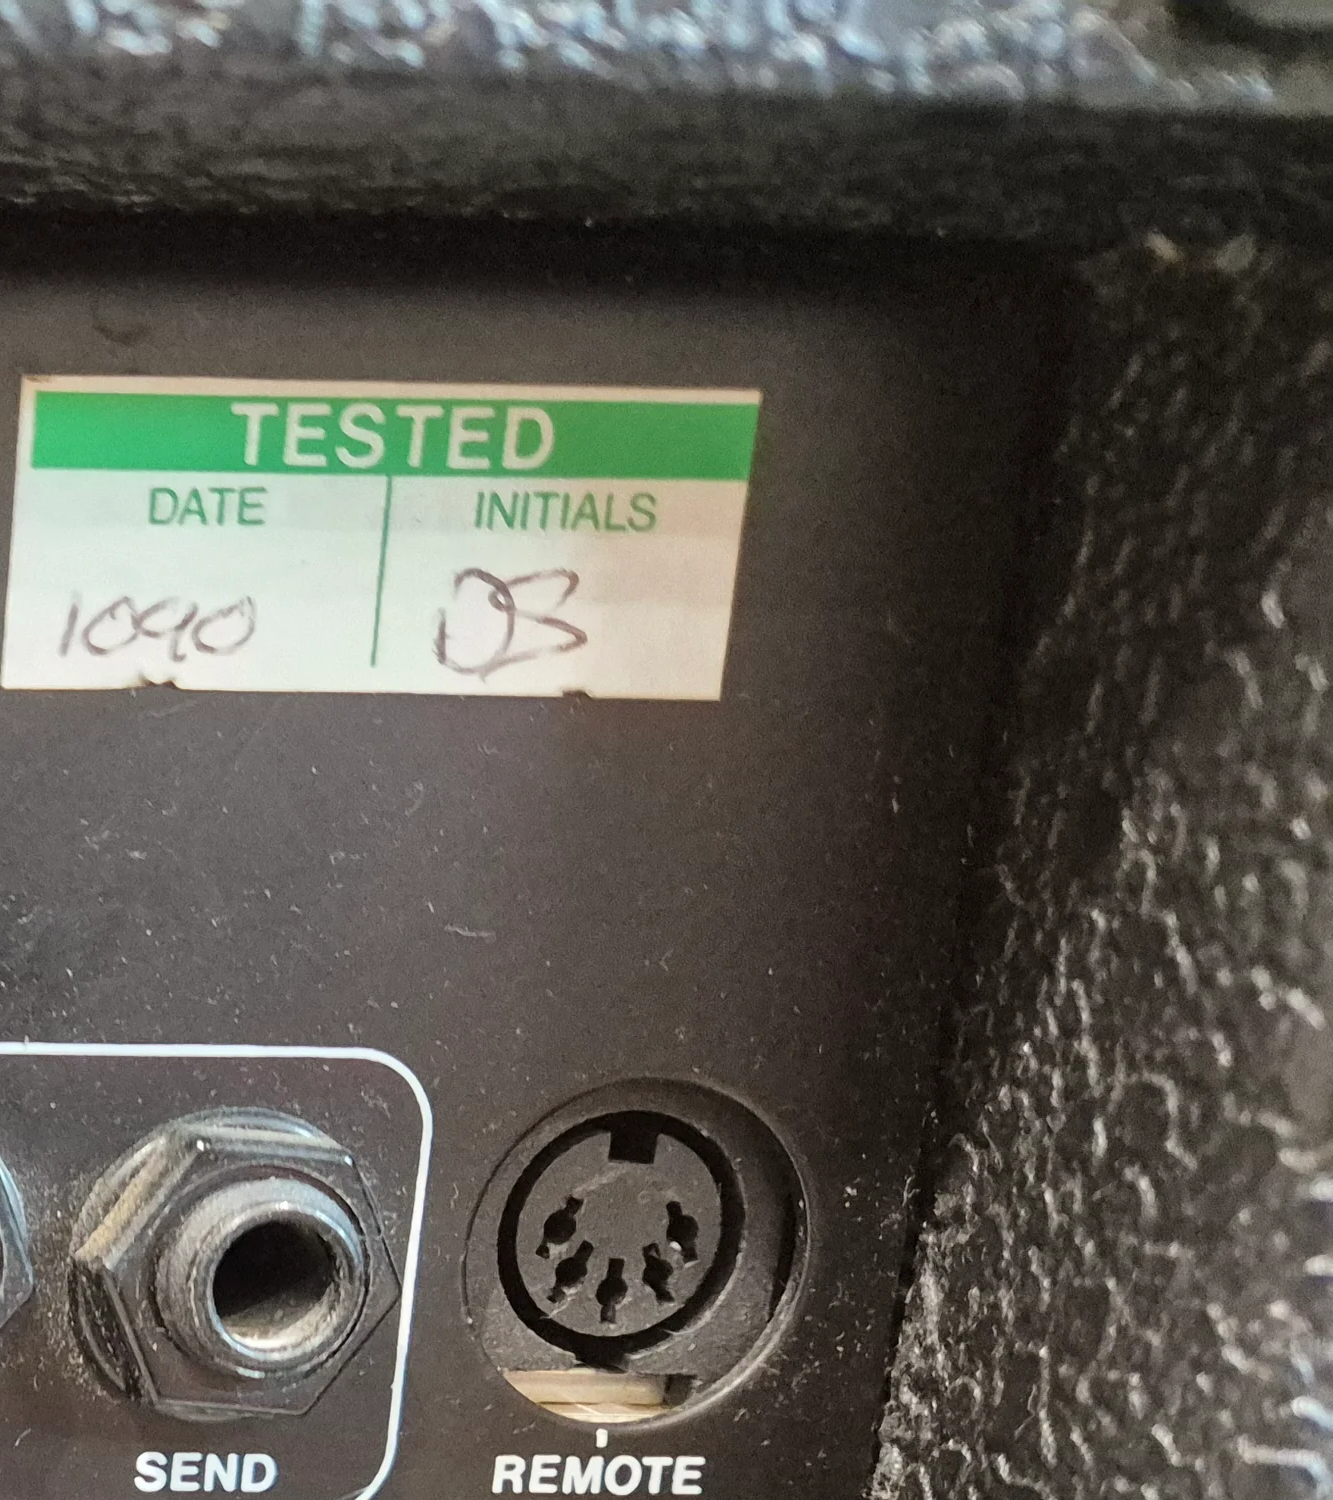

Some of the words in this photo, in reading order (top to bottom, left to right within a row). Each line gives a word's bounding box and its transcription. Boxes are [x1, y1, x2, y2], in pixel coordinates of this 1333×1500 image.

[231, 402, 555, 470] TESTED
[147, 487, 267, 528] DATE
[473, 492, 658, 533] INITIALS
[134, 1452, 277, 1494] SEND
[491, 1454, 706, 1495] REMOTE
